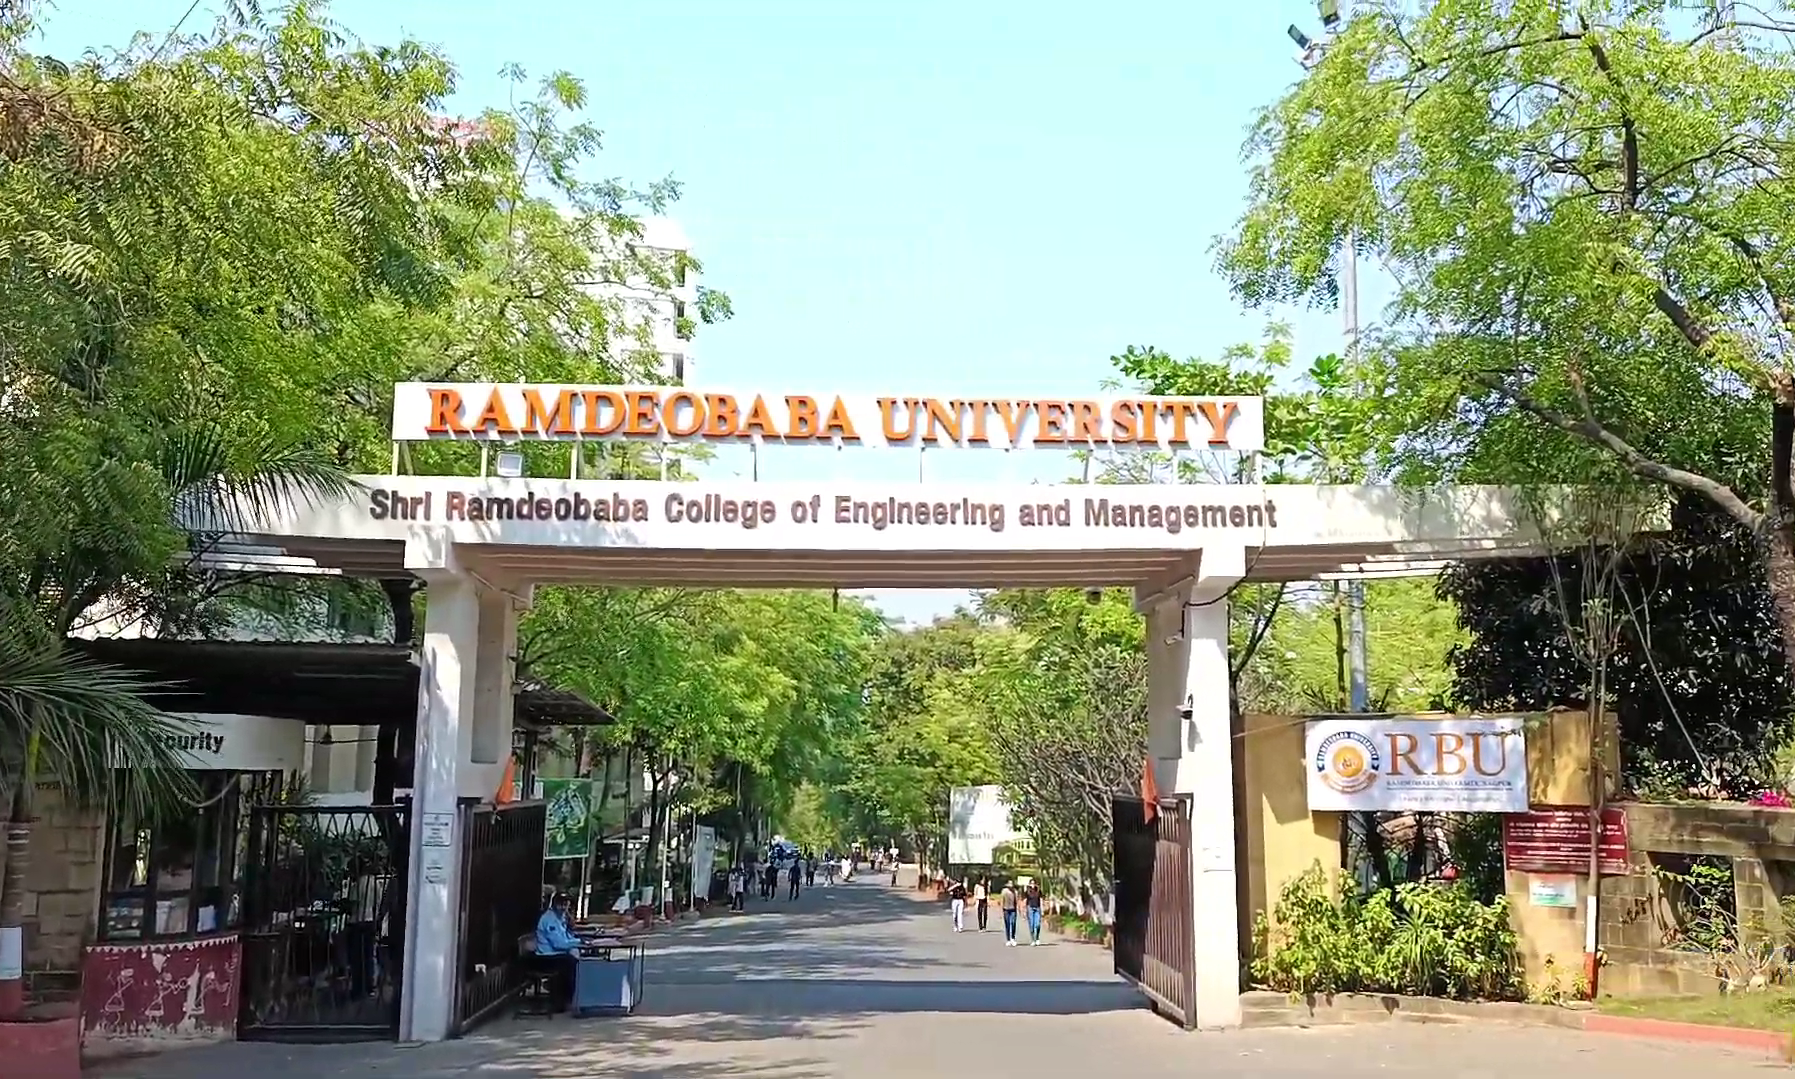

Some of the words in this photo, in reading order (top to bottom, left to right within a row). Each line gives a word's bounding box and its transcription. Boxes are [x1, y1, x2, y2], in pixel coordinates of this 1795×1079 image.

[425, 387, 859, 440] RAMDEOBABA
[876, 397, 1240, 445] UNIVERSITY
[369, 488, 433, 521] Shri
[445, 490, 649, 523] Ramdeobaba
[664, 493, 776, 530] College
[790, 494, 820, 523] of
[834, 495, 1005, 532] Engineering
[1019, 499, 1071, 527] and
[1084, 499, 1278, 534] Management
[158, 731, 224, 754] curity
[1384, 732, 1512, 777] RBU
